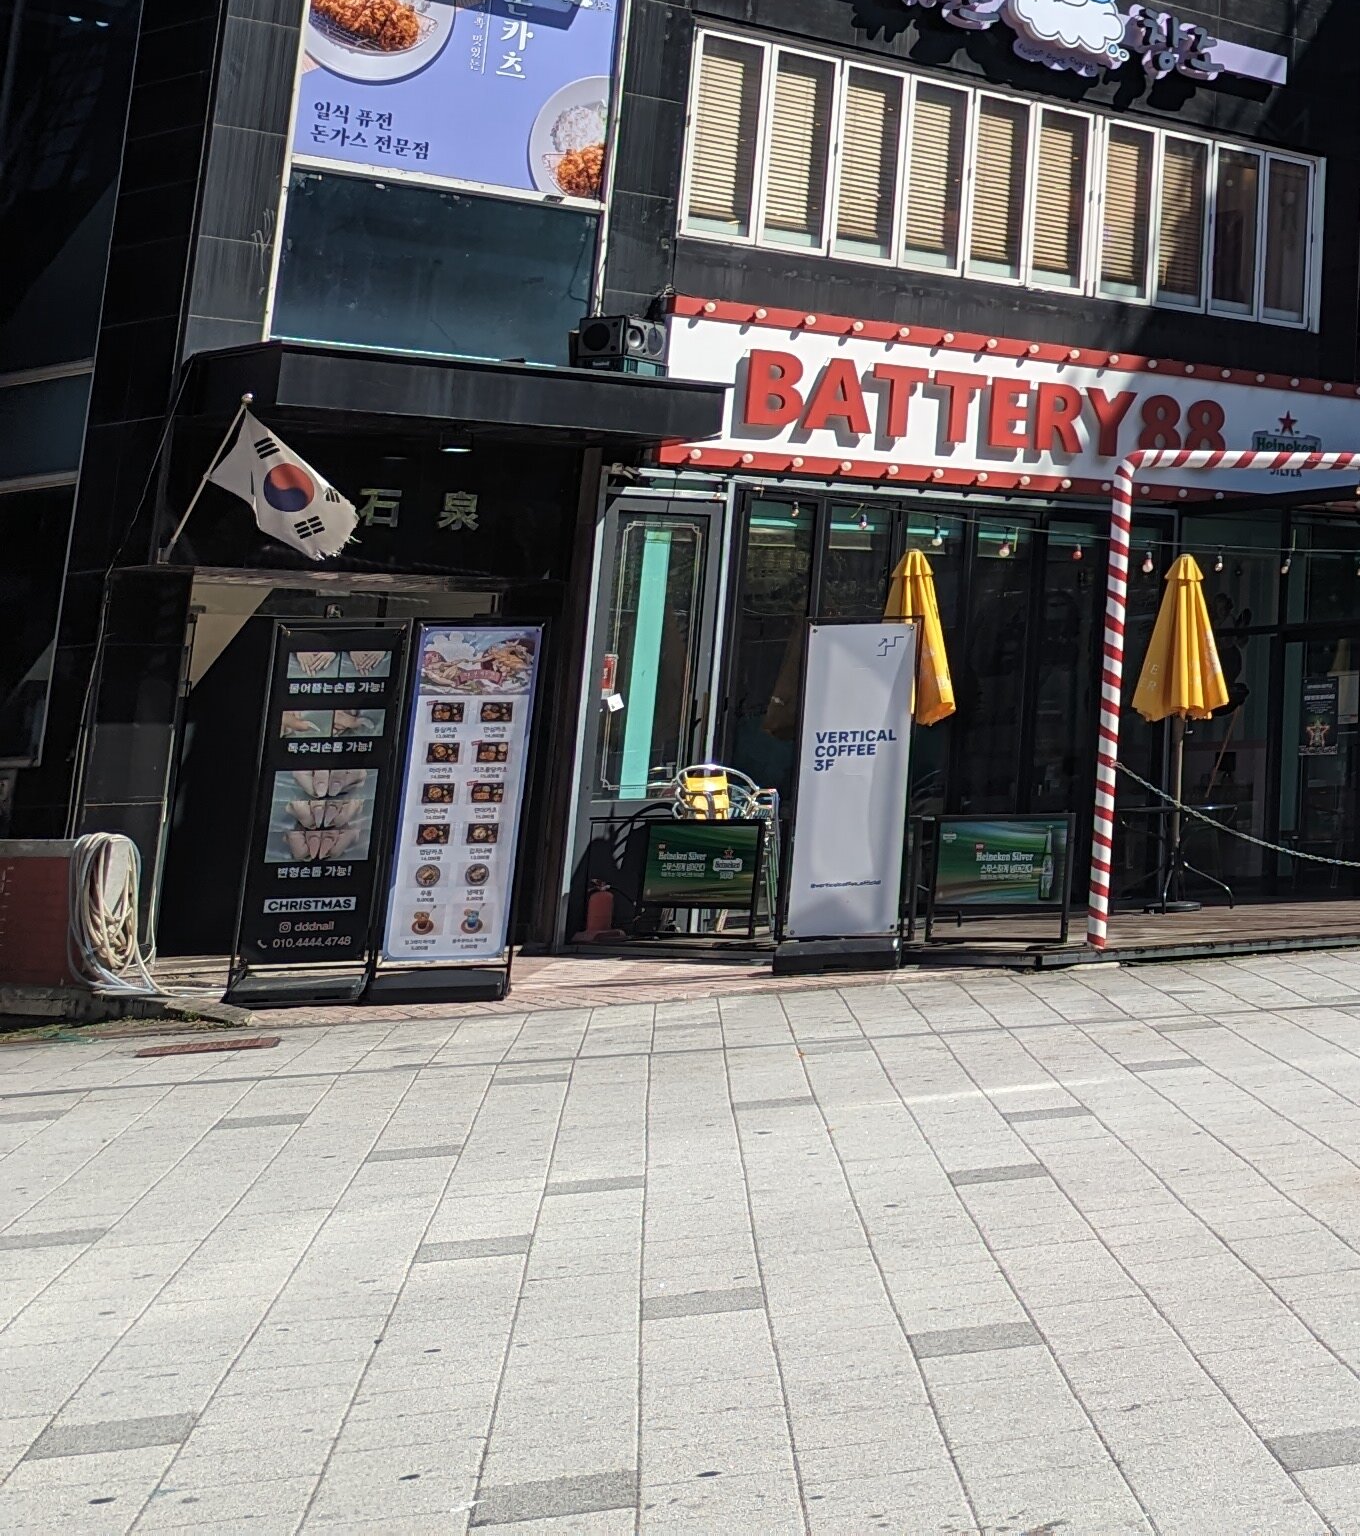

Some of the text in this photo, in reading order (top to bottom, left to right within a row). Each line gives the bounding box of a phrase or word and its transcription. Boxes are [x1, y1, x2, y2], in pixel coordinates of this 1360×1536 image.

[313, 101, 394, 131] 일식 퓨전
[310, 124, 430, 160] 돈가스 전문점
[743, 348, 1227, 457] BATTERY88
[358, 488, 480, 533] 石泉
[358, 681, 385, 693] 가능!
[815, 728, 898, 744] VERTICAL
[345, 741, 373, 752] 가능!
[815, 743, 877, 758] COFFEE
[813, 758, 836, 772] 3F
[658, 851, 708, 861] Heineken Silver
[975, 851, 1034, 862] Heineken Silver
[325, 865, 352, 877] 가능!
[268, 899, 352, 912] CHRISTMAS
[272, 936, 352, 948] 010.4444.4748
